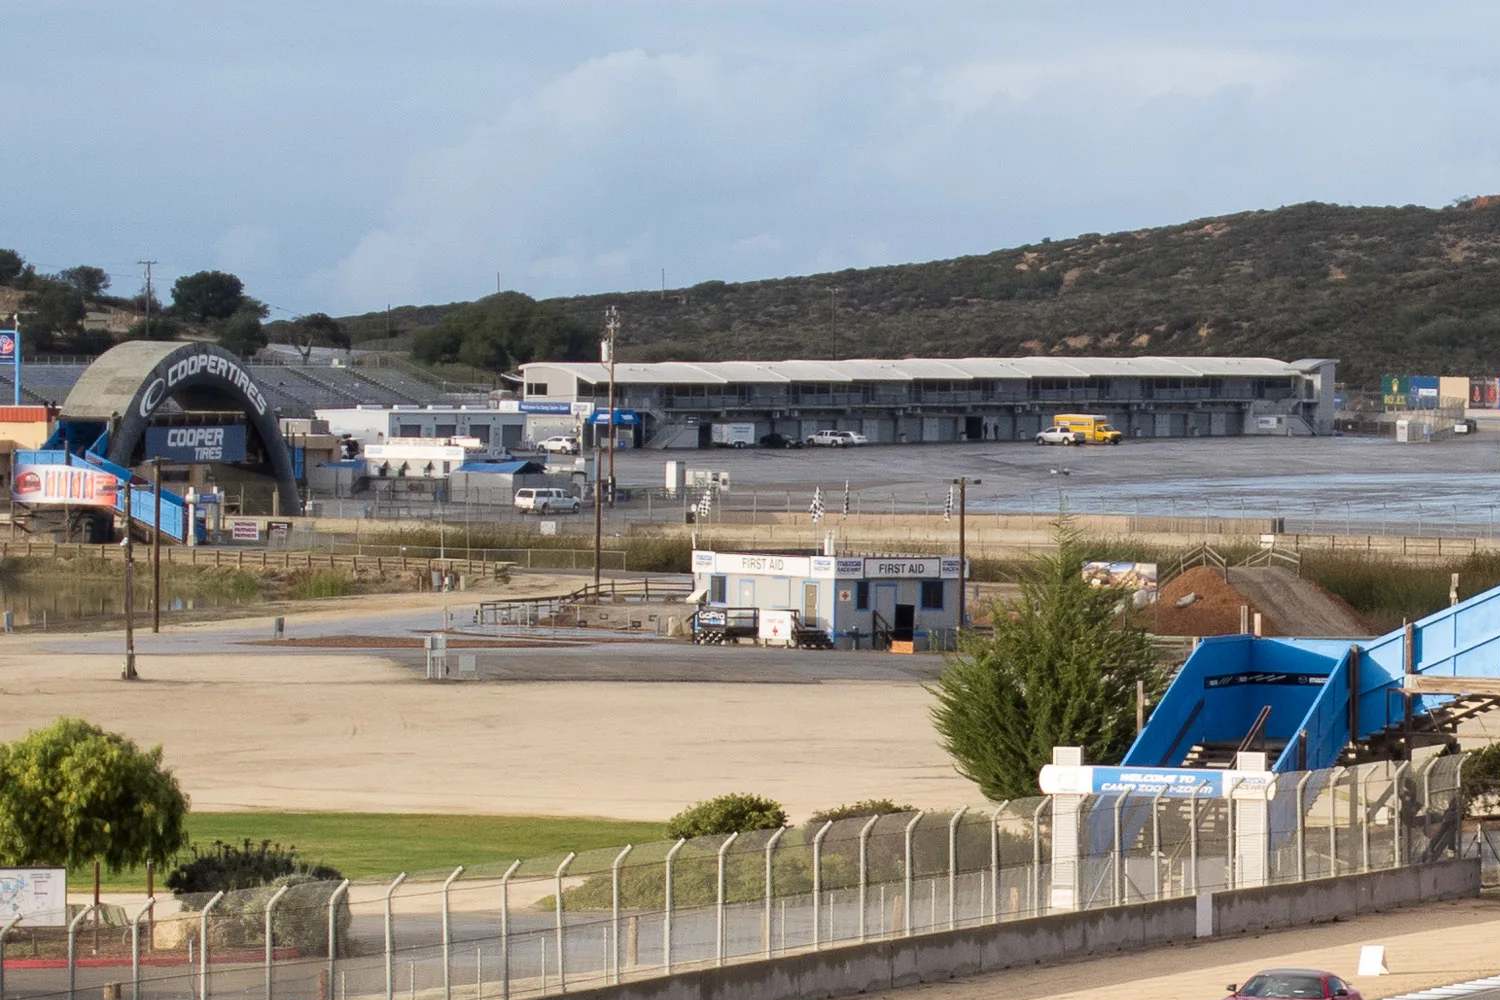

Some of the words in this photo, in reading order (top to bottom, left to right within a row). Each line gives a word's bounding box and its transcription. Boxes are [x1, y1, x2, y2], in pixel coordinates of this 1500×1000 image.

[167, 428, 224, 447] COOPER
[194, 446, 222, 460] TIRES
[741, 557, 767, 570] FIRST
[769, 558, 784, 571] AID
[878, 563, 906, 574] FIRST
[908, 563, 925, 574] AID
[698, 610, 725, 620] GoPro
[1120, 773, 1177, 783] WELCOME
[1179, 775, 1196, 784] TO
